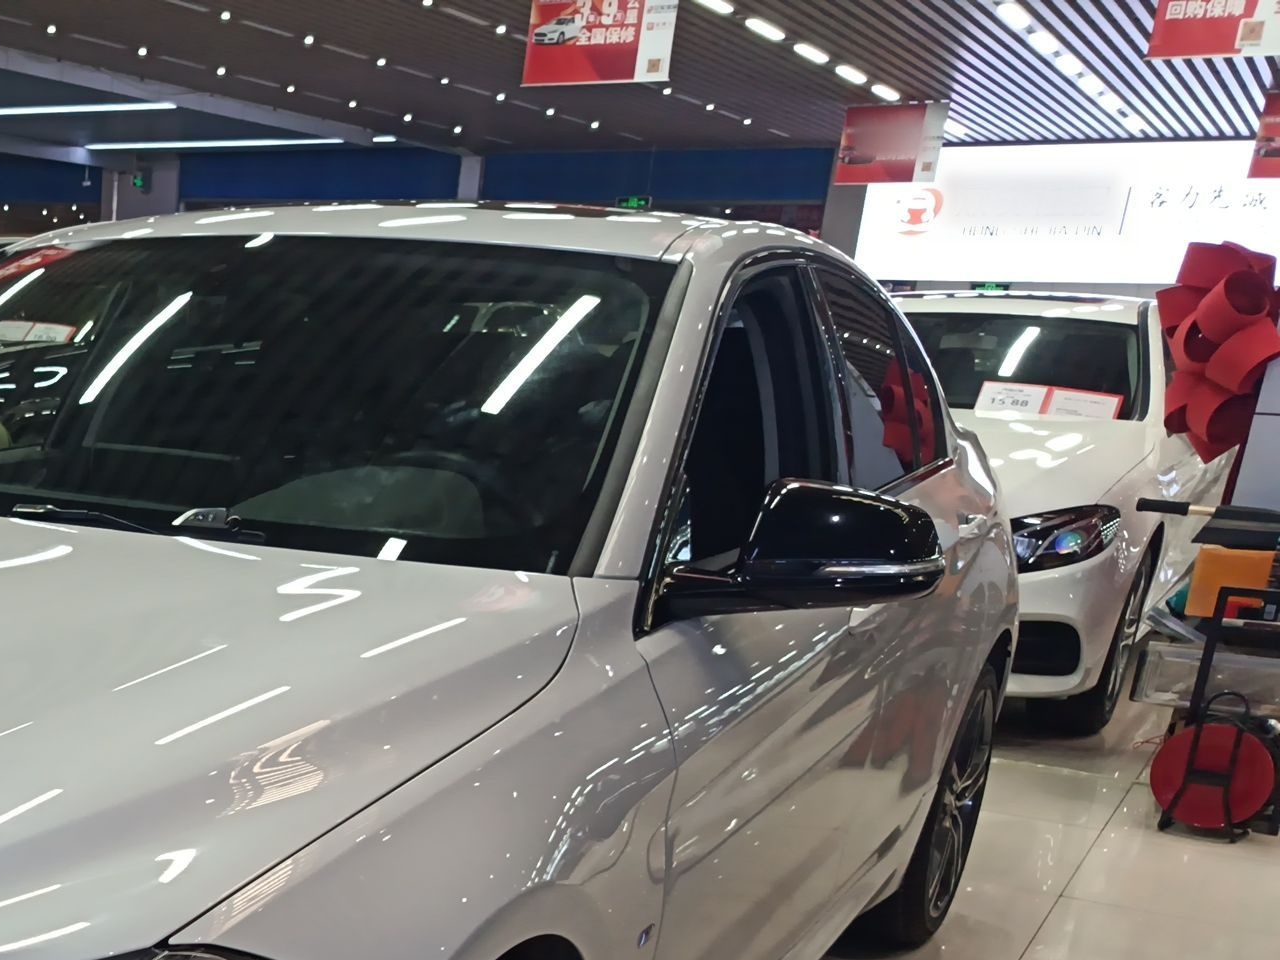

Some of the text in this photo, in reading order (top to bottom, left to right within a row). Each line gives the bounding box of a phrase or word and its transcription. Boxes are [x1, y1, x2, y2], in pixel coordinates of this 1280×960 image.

[1164, 0, 1247, 20] 回购保障
[575, 26, 636, 46] 全国保修
[989, 397, 1029, 408] 1588
